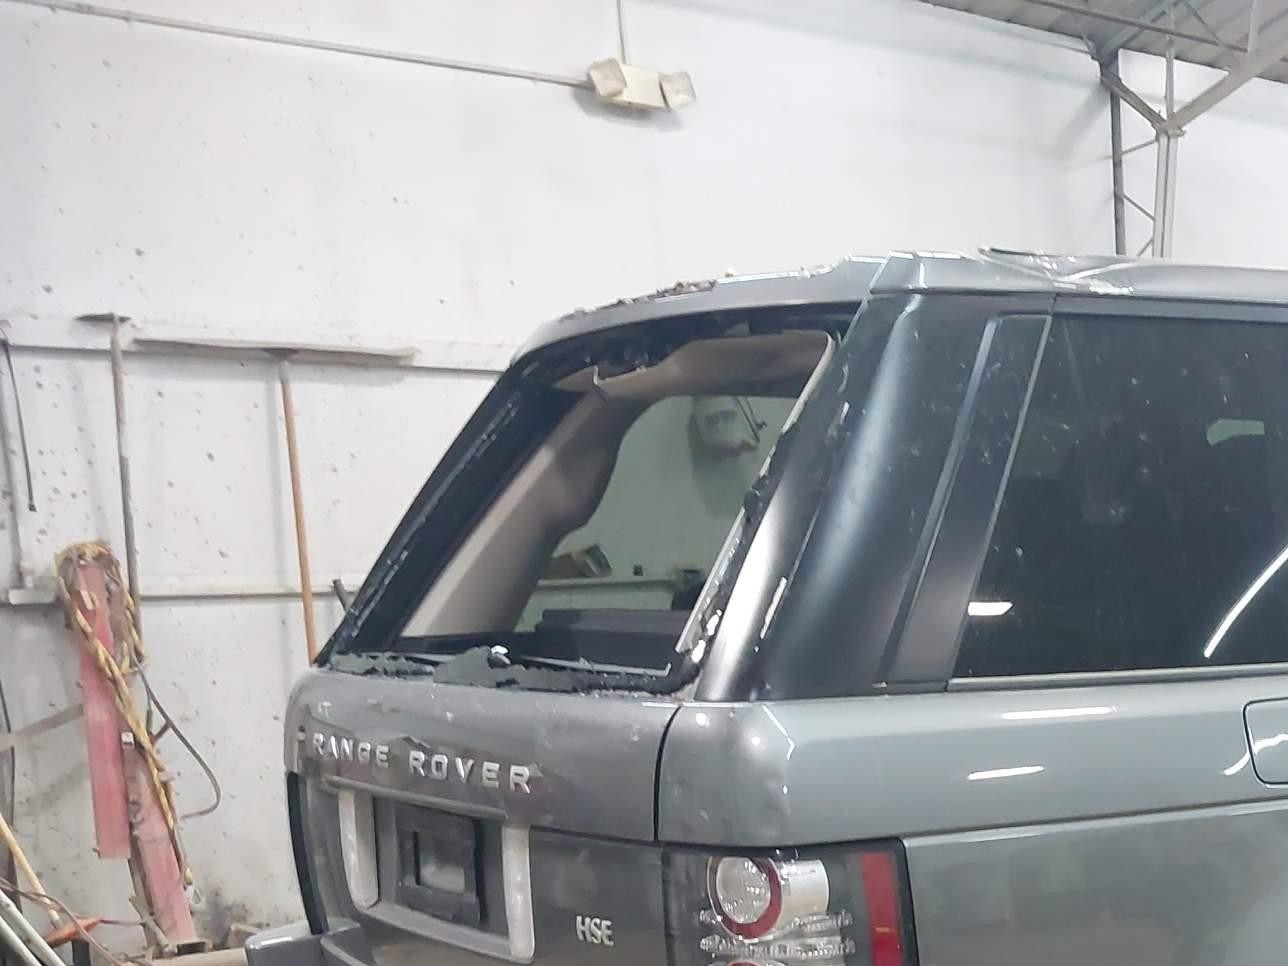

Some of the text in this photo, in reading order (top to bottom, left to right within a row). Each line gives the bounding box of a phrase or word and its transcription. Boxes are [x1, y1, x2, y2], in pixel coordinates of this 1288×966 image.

[312, 732, 532, 795] RANGE ROVER
[575, 915, 615, 947] HSE
